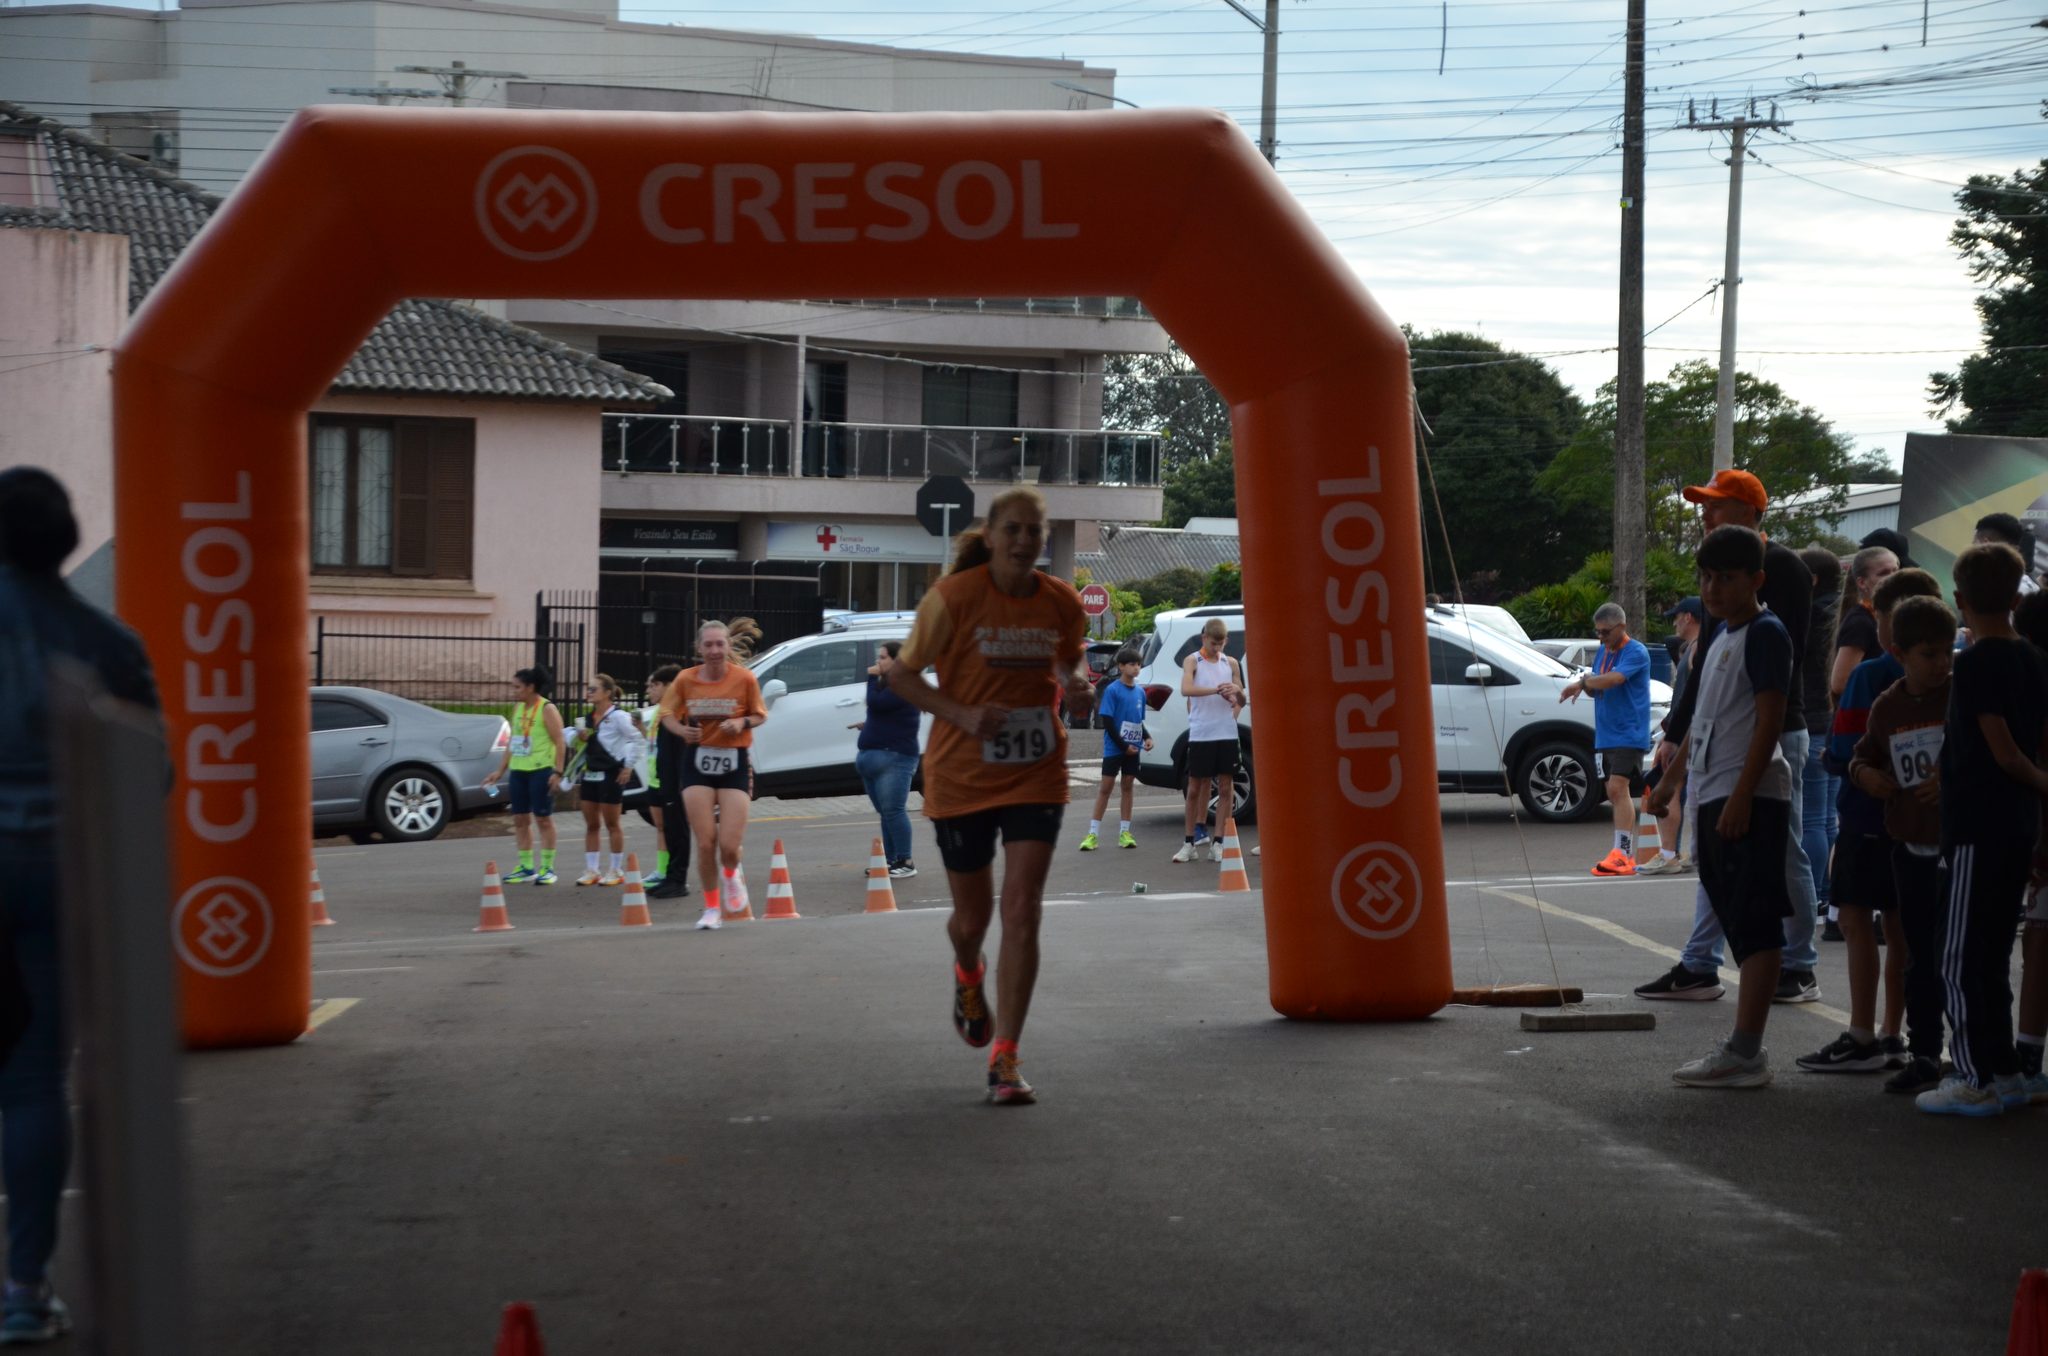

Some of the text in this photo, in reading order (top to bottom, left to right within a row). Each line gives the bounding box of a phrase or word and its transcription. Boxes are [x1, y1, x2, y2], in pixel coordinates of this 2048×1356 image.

[638, 159, 1081, 245] CRESOL
[633, 527, 718, 541] Vestindo Seu Estilo
[1083, 594, 1105, 605] PARE
[1317, 445, 1403, 808] CRESOL
[180, 469, 258, 842] CRESOL
[993, 727, 1048, 760] 519
[701, 755, 732, 773] 679
